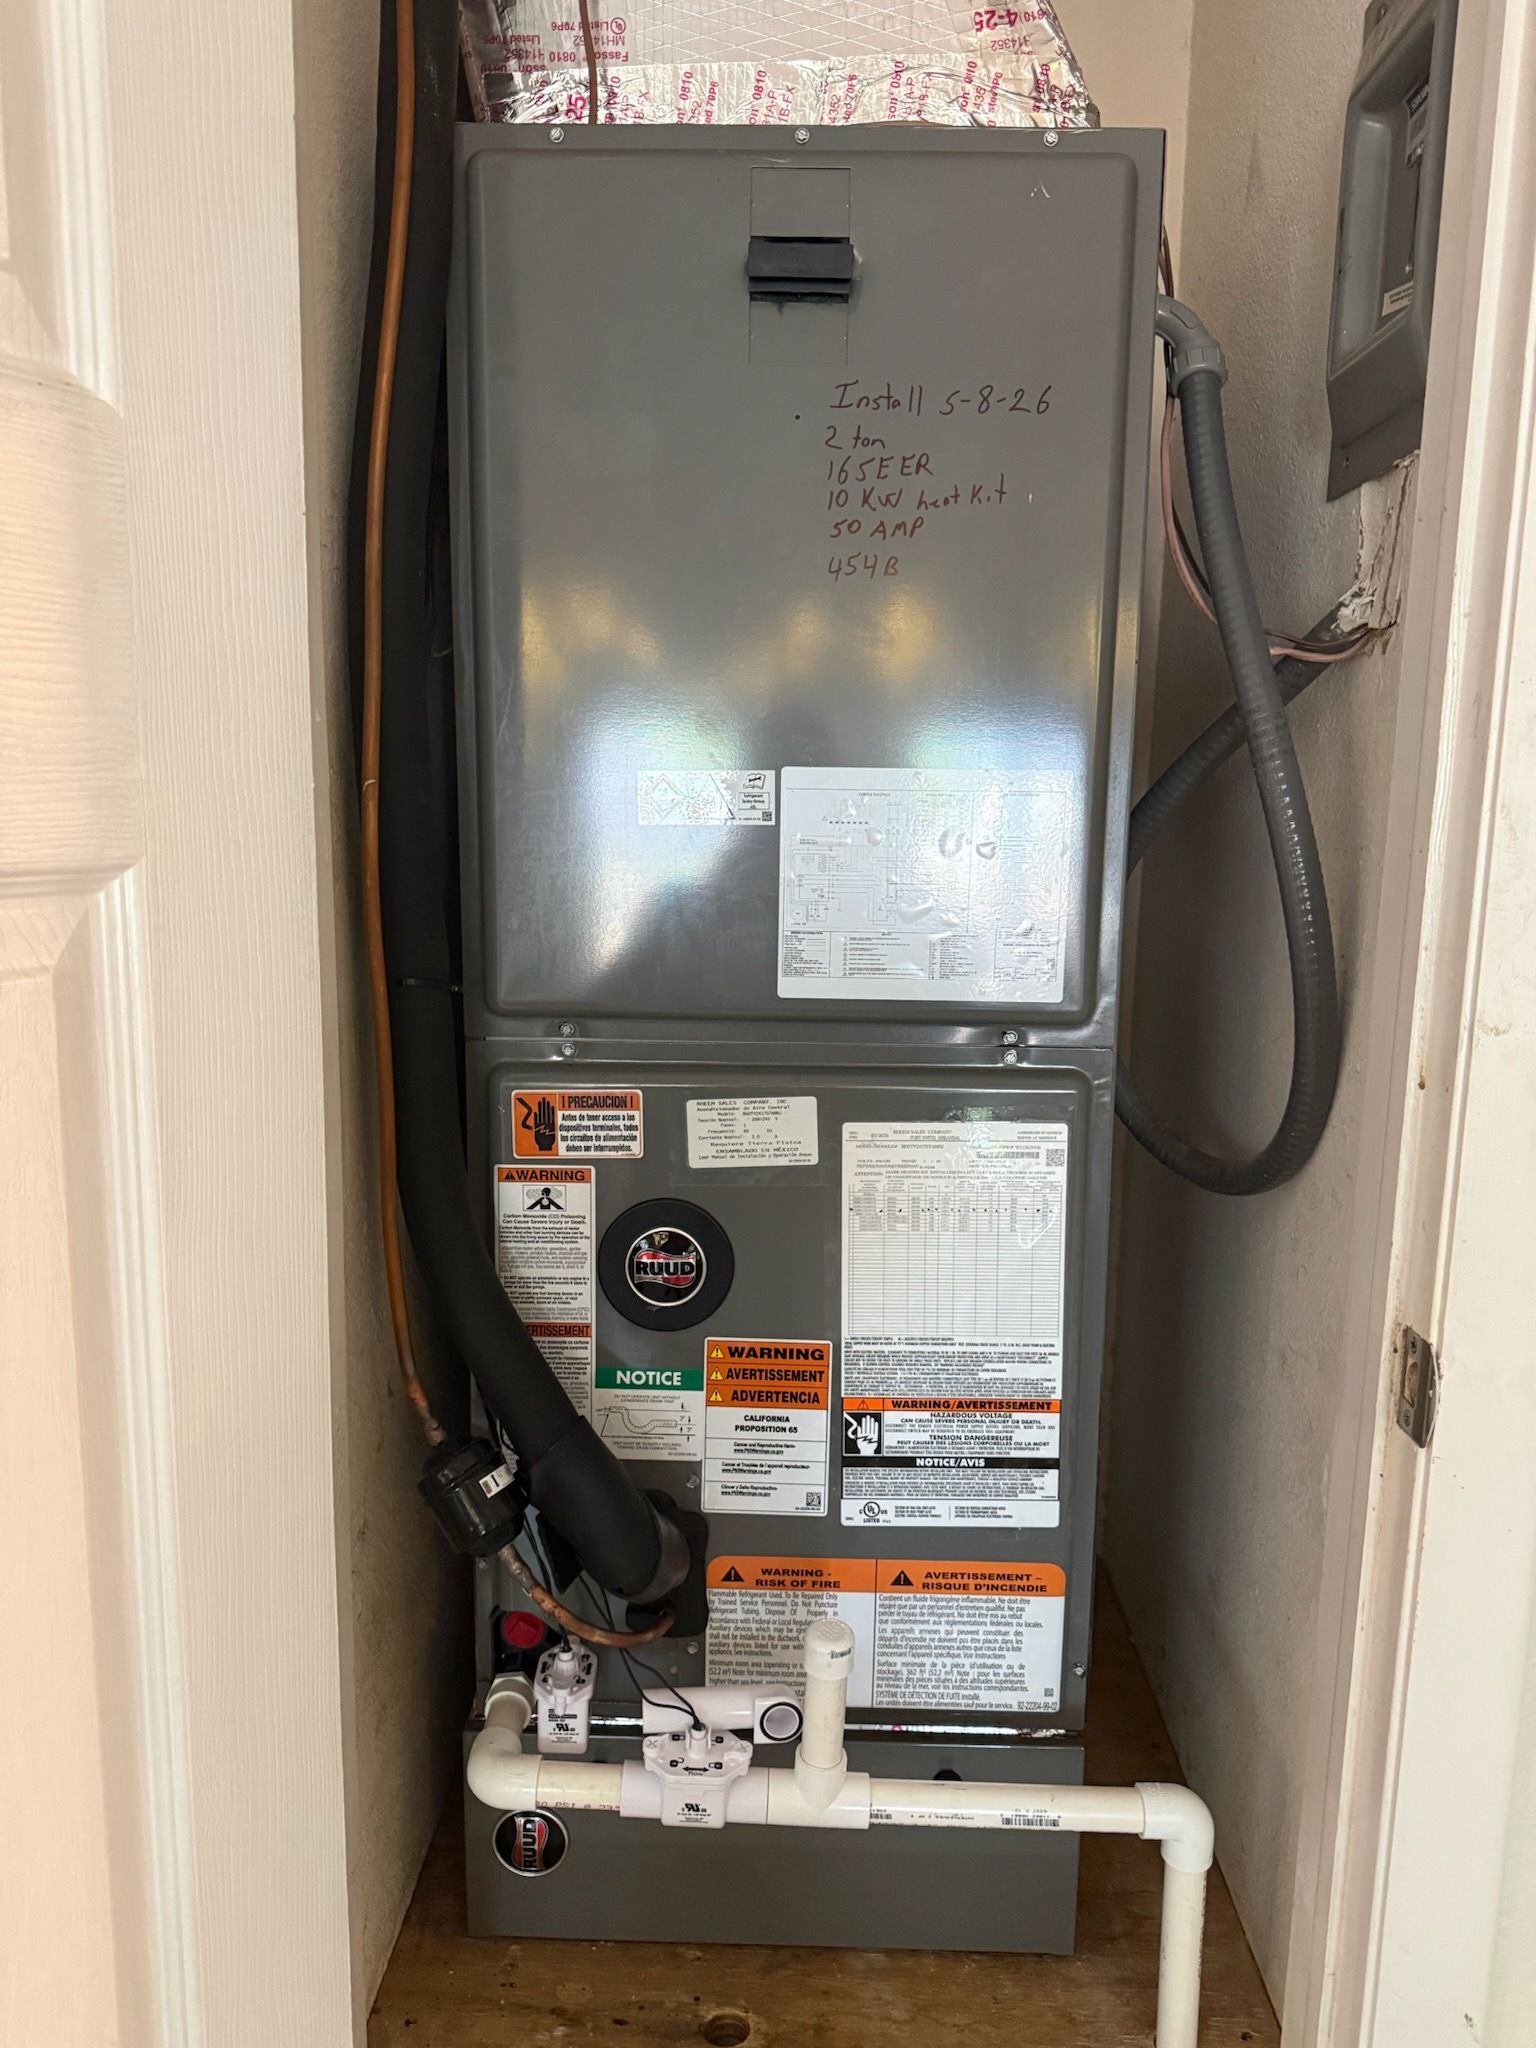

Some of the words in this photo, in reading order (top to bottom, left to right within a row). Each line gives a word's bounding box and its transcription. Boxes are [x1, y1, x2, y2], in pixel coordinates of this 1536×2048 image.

[974, 9, 1017, 32] 4-25
[579, 21, 608, 31] Listd
[573, 35, 625, 46] MH1452
[551, 52, 576, 62] 0810
[679, 71, 694, 101] 0810
[752, 70, 768, 101] 0810
[830, 380, 923, 416] Install
[939, 385, 1052, 415] 5-8-26
[825, 426, 843, 450] 2
[828, 490, 848, 510] 10
[830, 519, 861, 538] 50
[568, 1096, 627, 1108] PRECAUCION
[561, 1113, 577, 1121] Antes
[627, 1113, 635, 1121] los
[559, 1124, 591, 1132] dispositivos
[566, 1144, 582, 1152] deben
[516, 1170, 584, 1181] WARNING
[635, 1262, 694, 1275] RUUD
[728, 1347, 824, 1360] WARNING
[616, 1370, 682, 1385] NOTICE
[726, 1368, 824, 1382] AVERTISSEMENT
[731, 1390, 820, 1404] ADVERTENCIA
[892, 1400, 1052, 1410] WARNING/AVERTISSEMENT
[744, 1415, 790, 1423] CALIFORNIA
[735, 1425, 786, 1433] PROPOSITION
[916, 1458, 985, 1467] NOTICE/AVIS
[761, 1568, 824, 1577] WARNING
[924, 1571, 1032, 1581] AVERTISSEMENT
[756, 1579, 786, 1587] RISK
[812, 1580, 840, 1588] FIRE
[922, 1582, 970, 1591] RISQUE
[739, 1591, 767, 1599] Refrigerant
[801, 1592, 824, 1600] Repaired
[765, 1608, 785, 1616] Dispose
[807, 1609, 828, 1617] Properly
[709, 1624, 731, 1632] Auxiliary
[709, 1641, 730, 1649] auxiliary
[522, 1819, 537, 1869] RUUD
